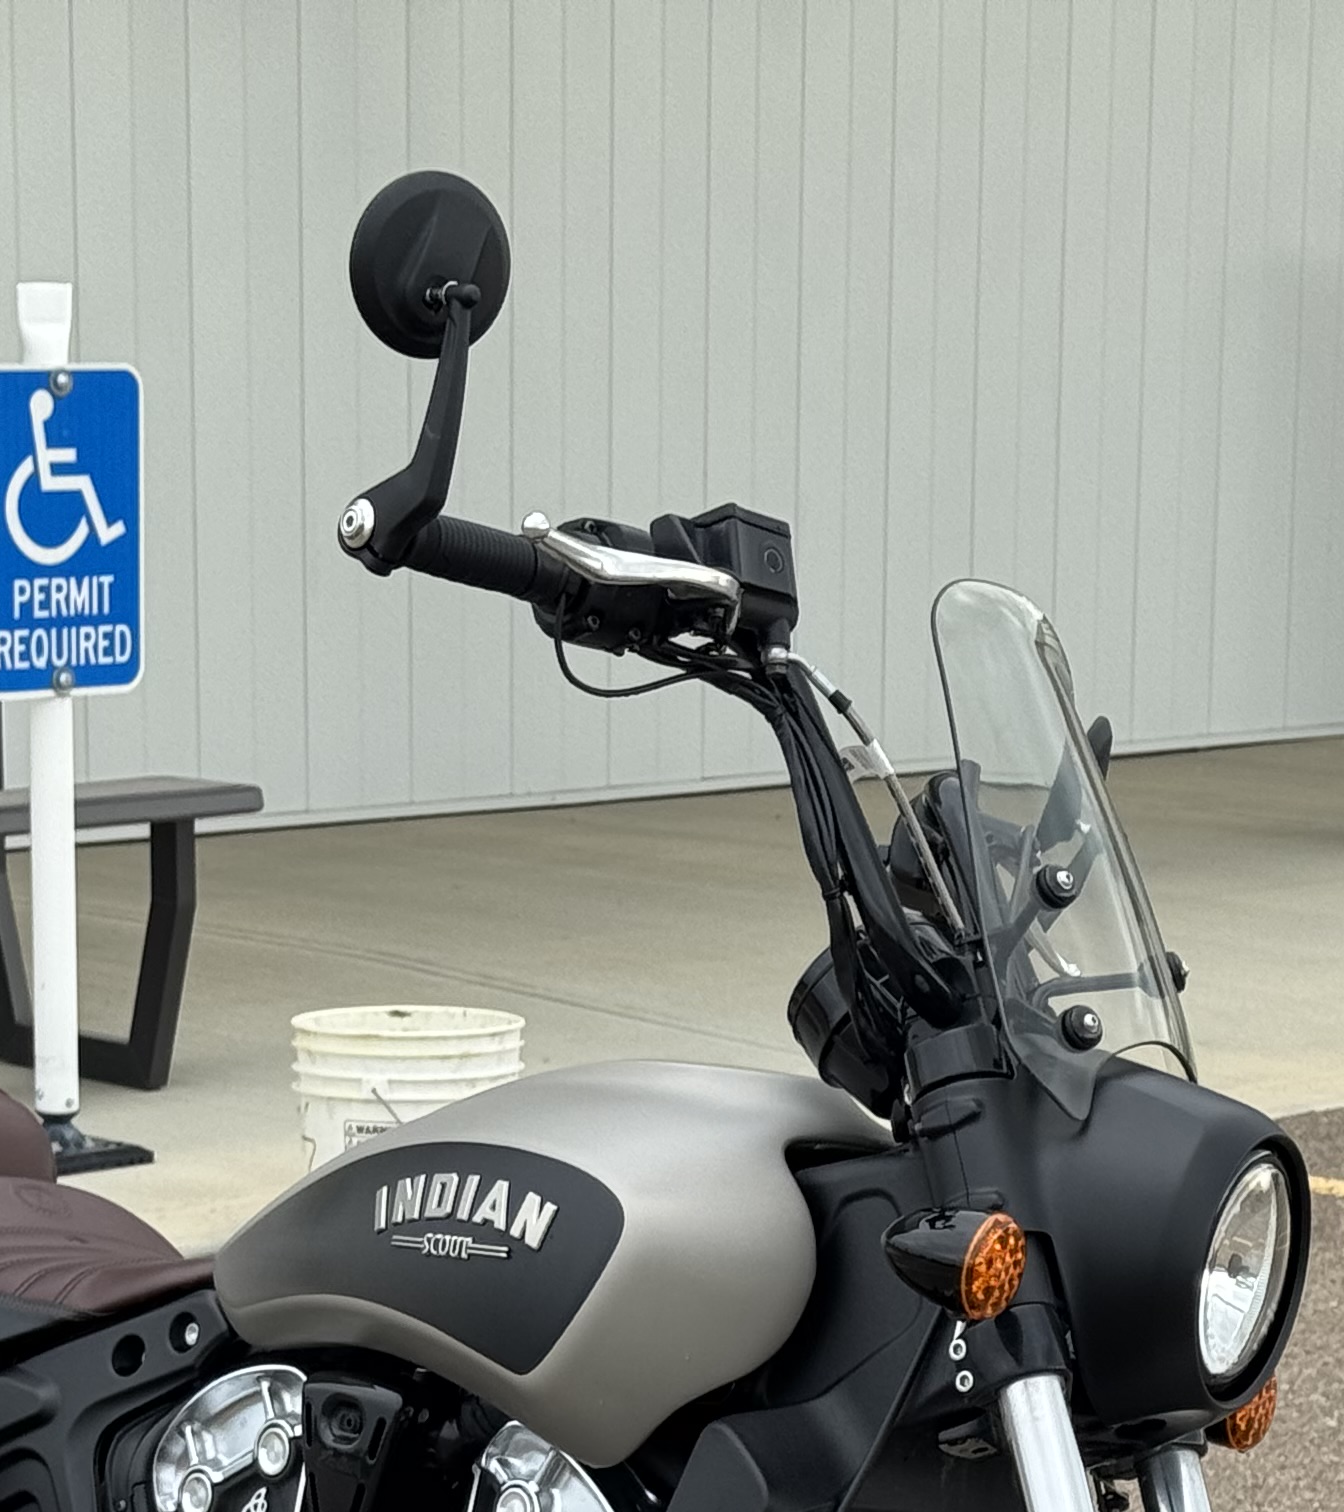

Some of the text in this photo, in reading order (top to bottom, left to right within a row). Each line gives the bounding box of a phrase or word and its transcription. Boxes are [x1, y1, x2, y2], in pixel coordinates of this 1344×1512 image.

[12, 574, 115, 620] PERMIT
[355, 1124, 392, 1135] WARN
[374, 1172, 559, 1251] INDIAN
[421, 1232, 473, 1260] SCOUT
